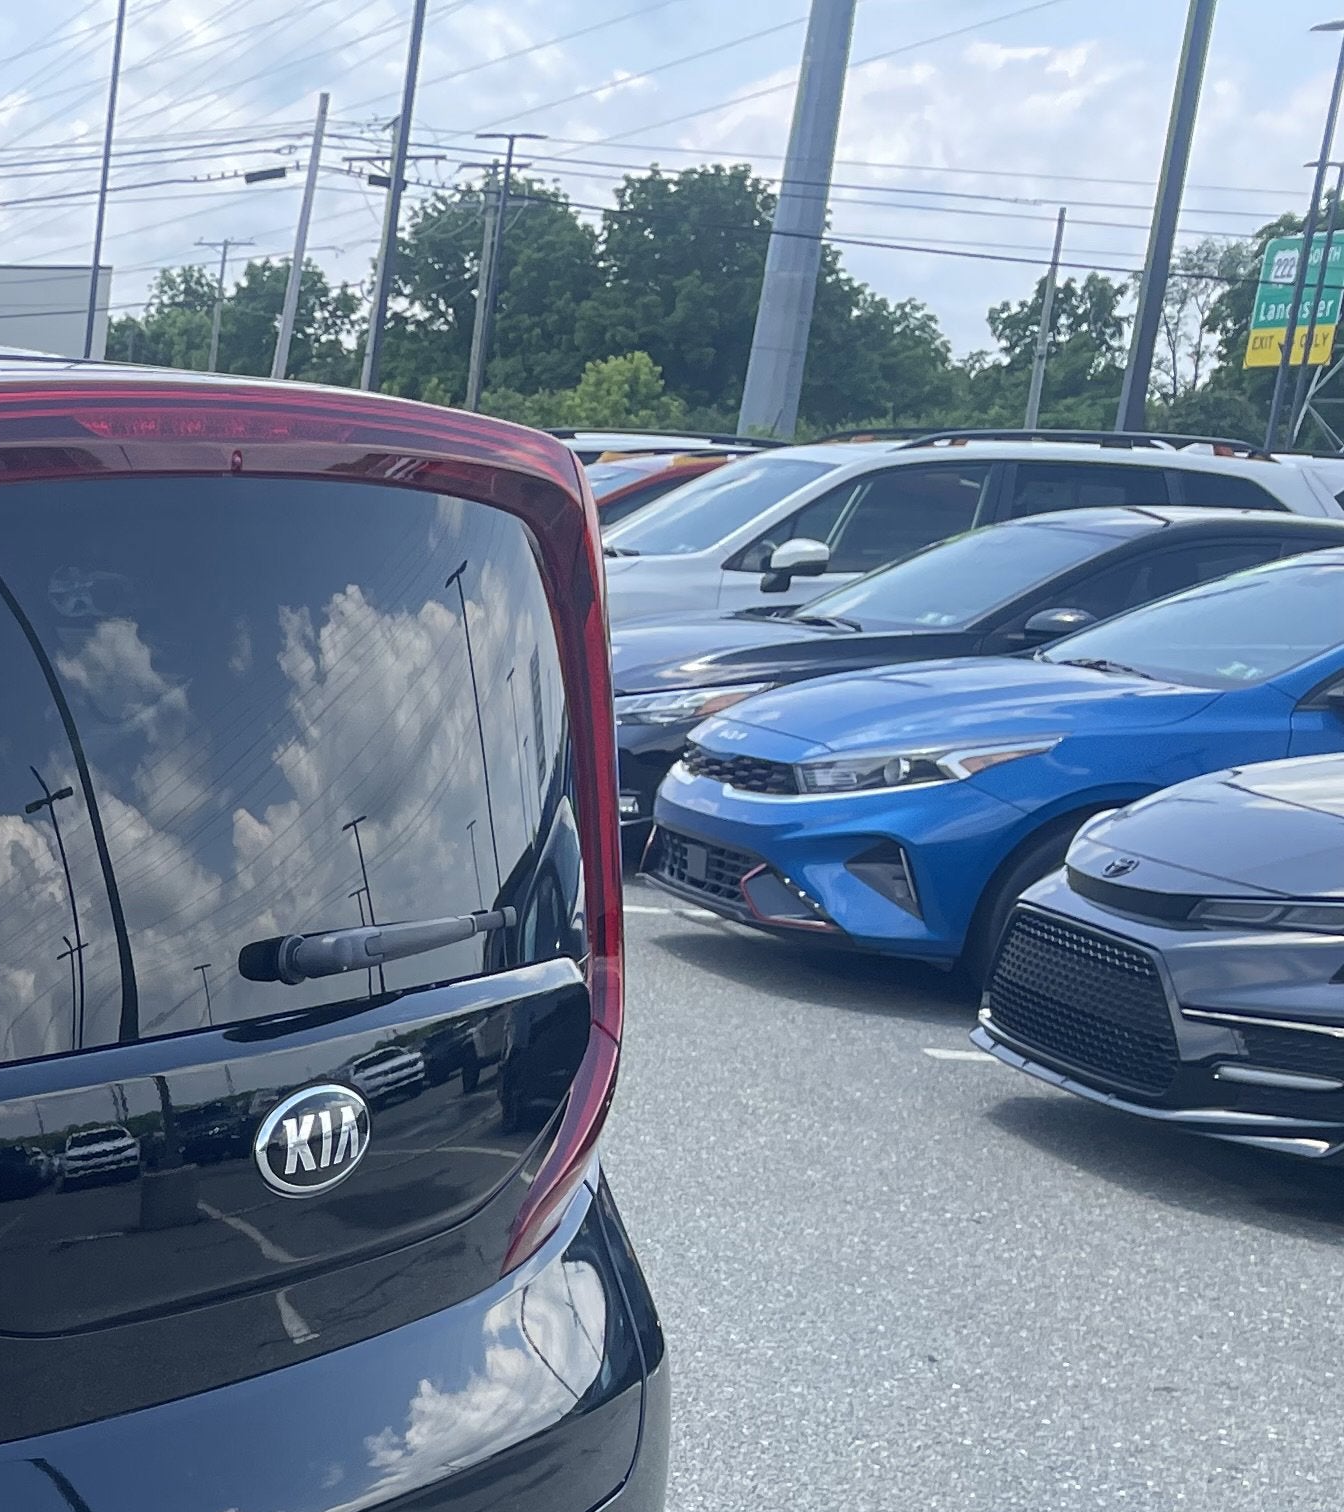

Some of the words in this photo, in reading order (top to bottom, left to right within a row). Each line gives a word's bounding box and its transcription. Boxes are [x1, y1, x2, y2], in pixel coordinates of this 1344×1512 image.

[1273, 256, 1296, 279] 222
[1258, 299, 1335, 322] Lancser
[1251, 335, 1275, 351] EXIT
[1299, 332, 1330, 348] OLY
[282, 1105, 360, 1175] KIA
